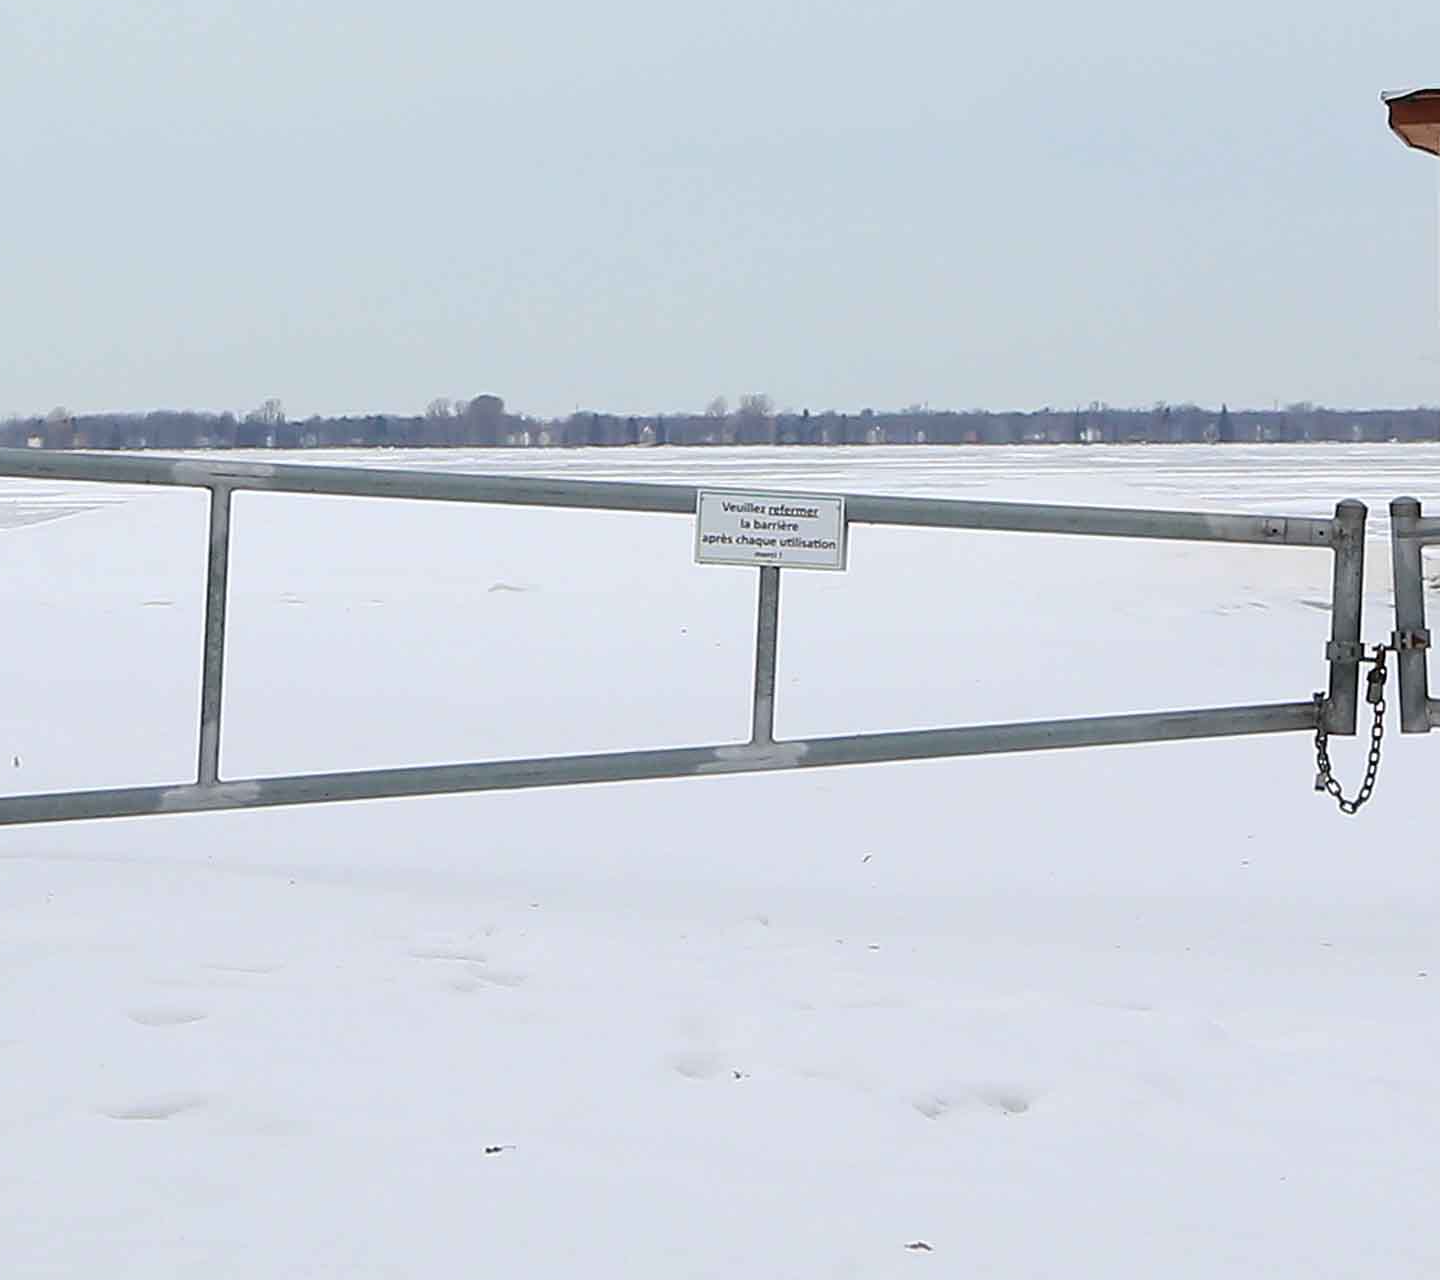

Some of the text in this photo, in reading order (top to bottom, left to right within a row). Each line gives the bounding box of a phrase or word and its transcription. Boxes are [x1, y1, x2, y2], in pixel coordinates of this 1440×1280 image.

[722, 501, 819, 517] Veuillez refermer
[740, 519, 799, 531] la barrière
[702, 533, 836, 550] après chaque utilisation
